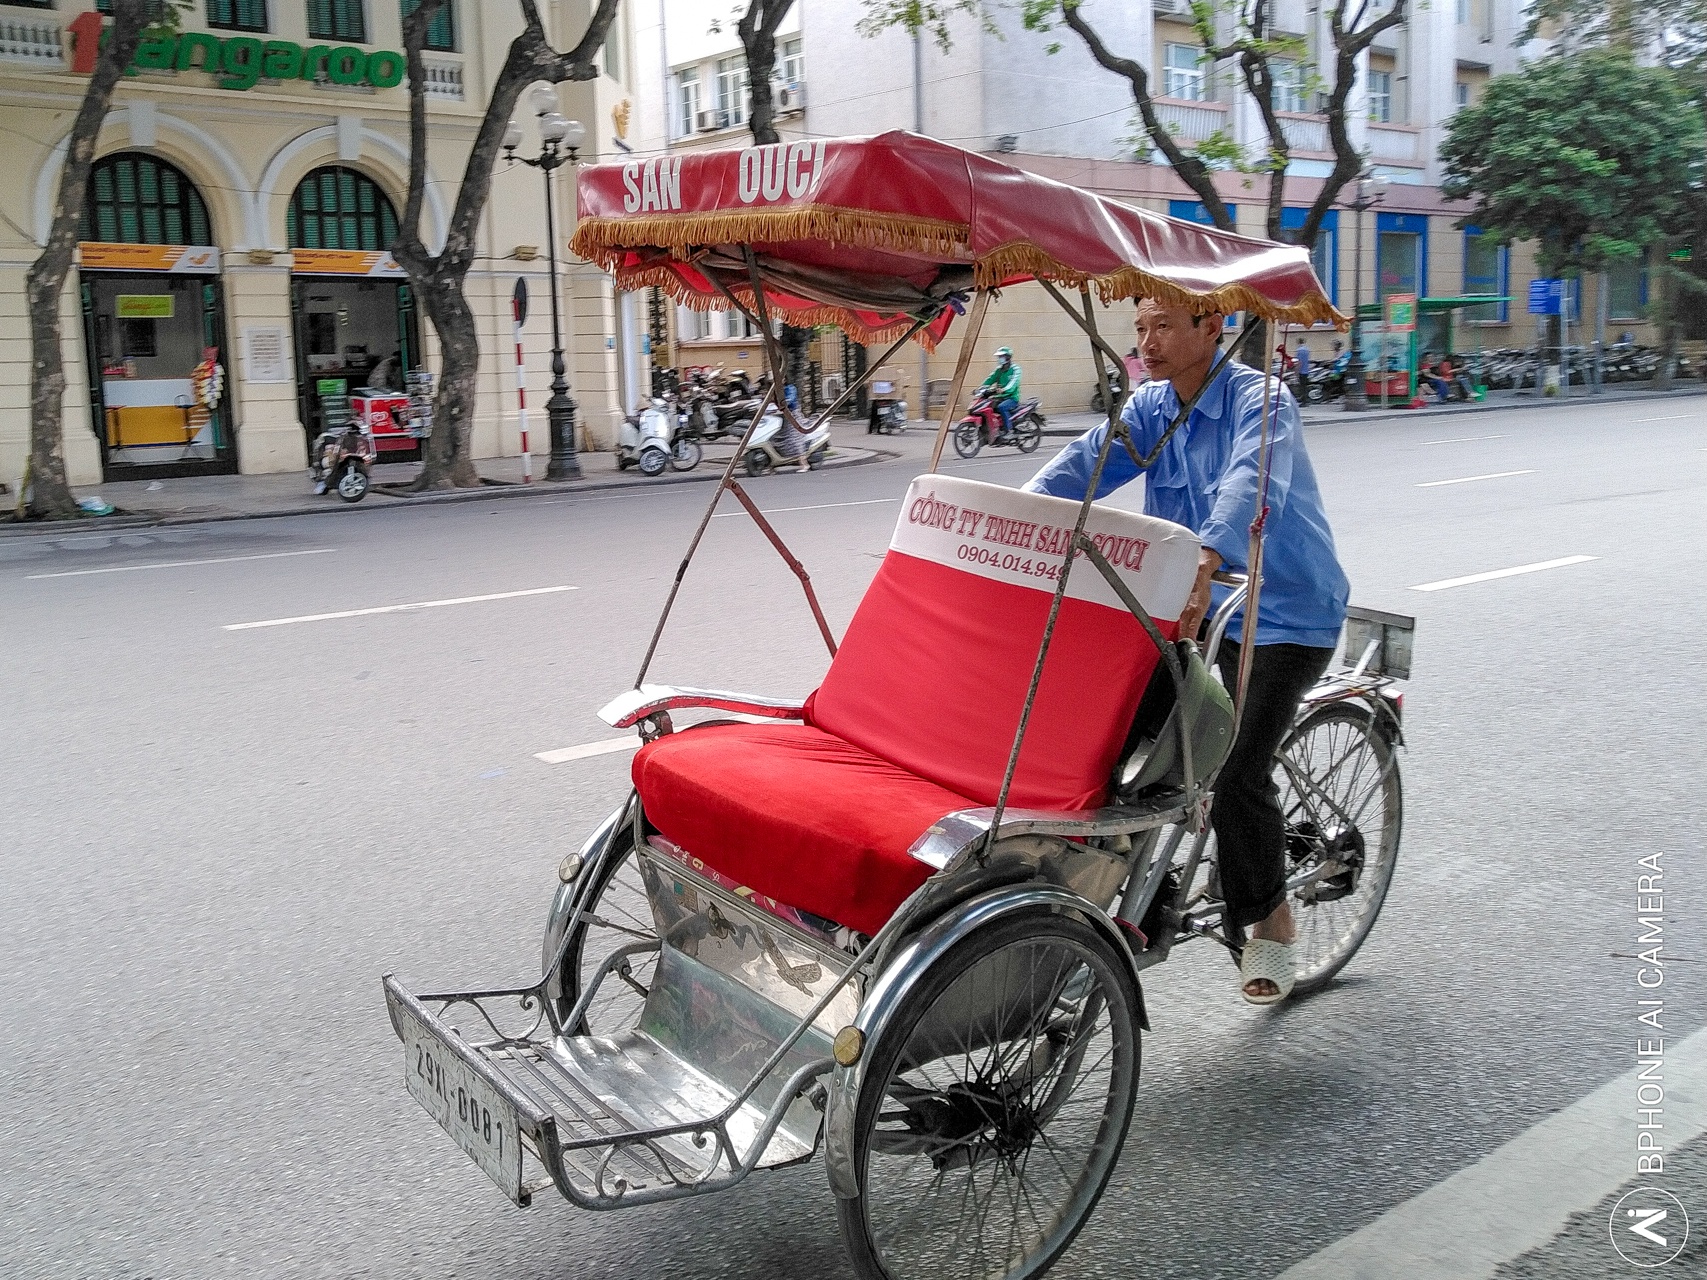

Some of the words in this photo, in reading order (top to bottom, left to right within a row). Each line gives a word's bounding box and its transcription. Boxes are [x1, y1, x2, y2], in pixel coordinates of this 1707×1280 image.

[100, 26, 407, 90] angaroo
[909, 491, 958, 532] CÔNG
[956, 508, 985, 538] TY
[981, 514, 1040, 550] TNHH
